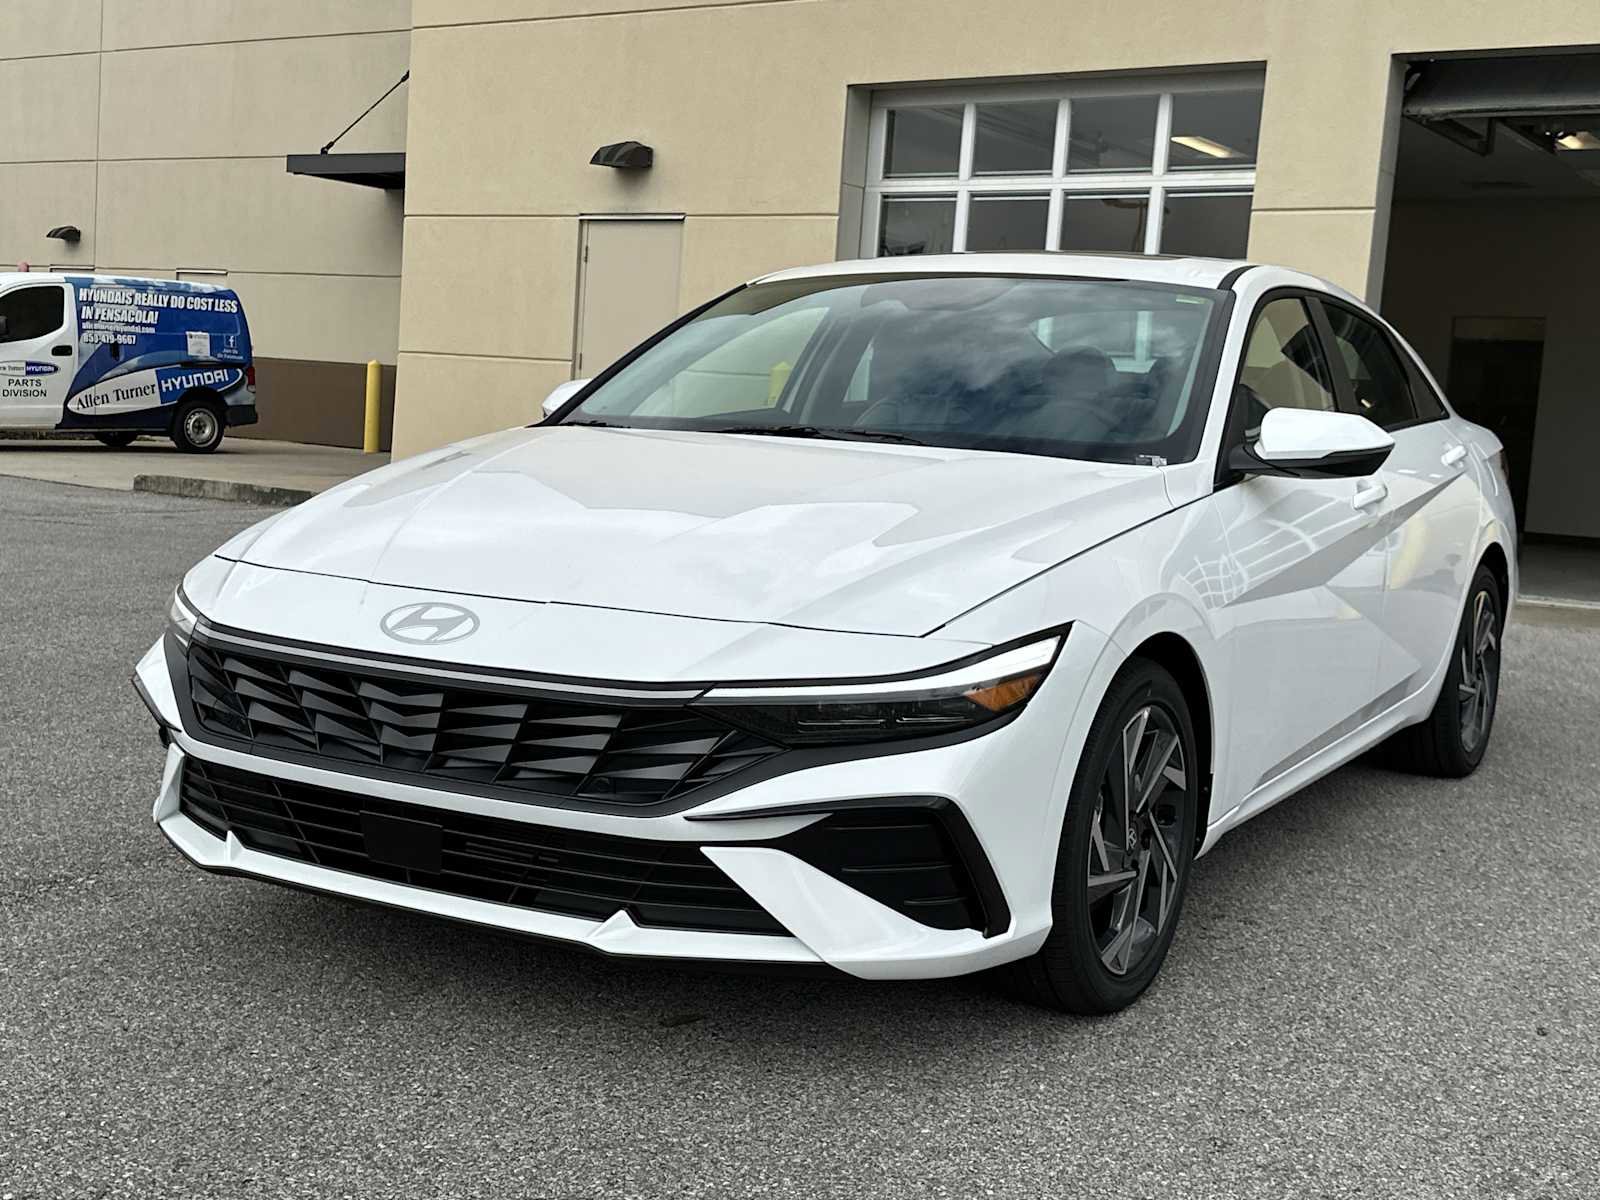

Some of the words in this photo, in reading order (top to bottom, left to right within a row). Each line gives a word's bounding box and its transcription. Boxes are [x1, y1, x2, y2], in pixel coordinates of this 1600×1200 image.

[79, 288, 133, 305] HYUNDAIS
[134, 292, 169, 307] REALLY
[170, 295, 185, 309] DO
[186, 296, 214, 311] COST
[214, 299, 238, 313] LESS
[81, 306, 93, 320] IN
[94, 307, 159, 324] PENSACOLA!
[8, 378, 42, 387] PARTS
[76, 393, 110, 411] Allen
[112, 383, 157, 402] Turner
[160, 369, 230, 393] HYUNDAI
[2, 389, 47, 398] DIVISION
